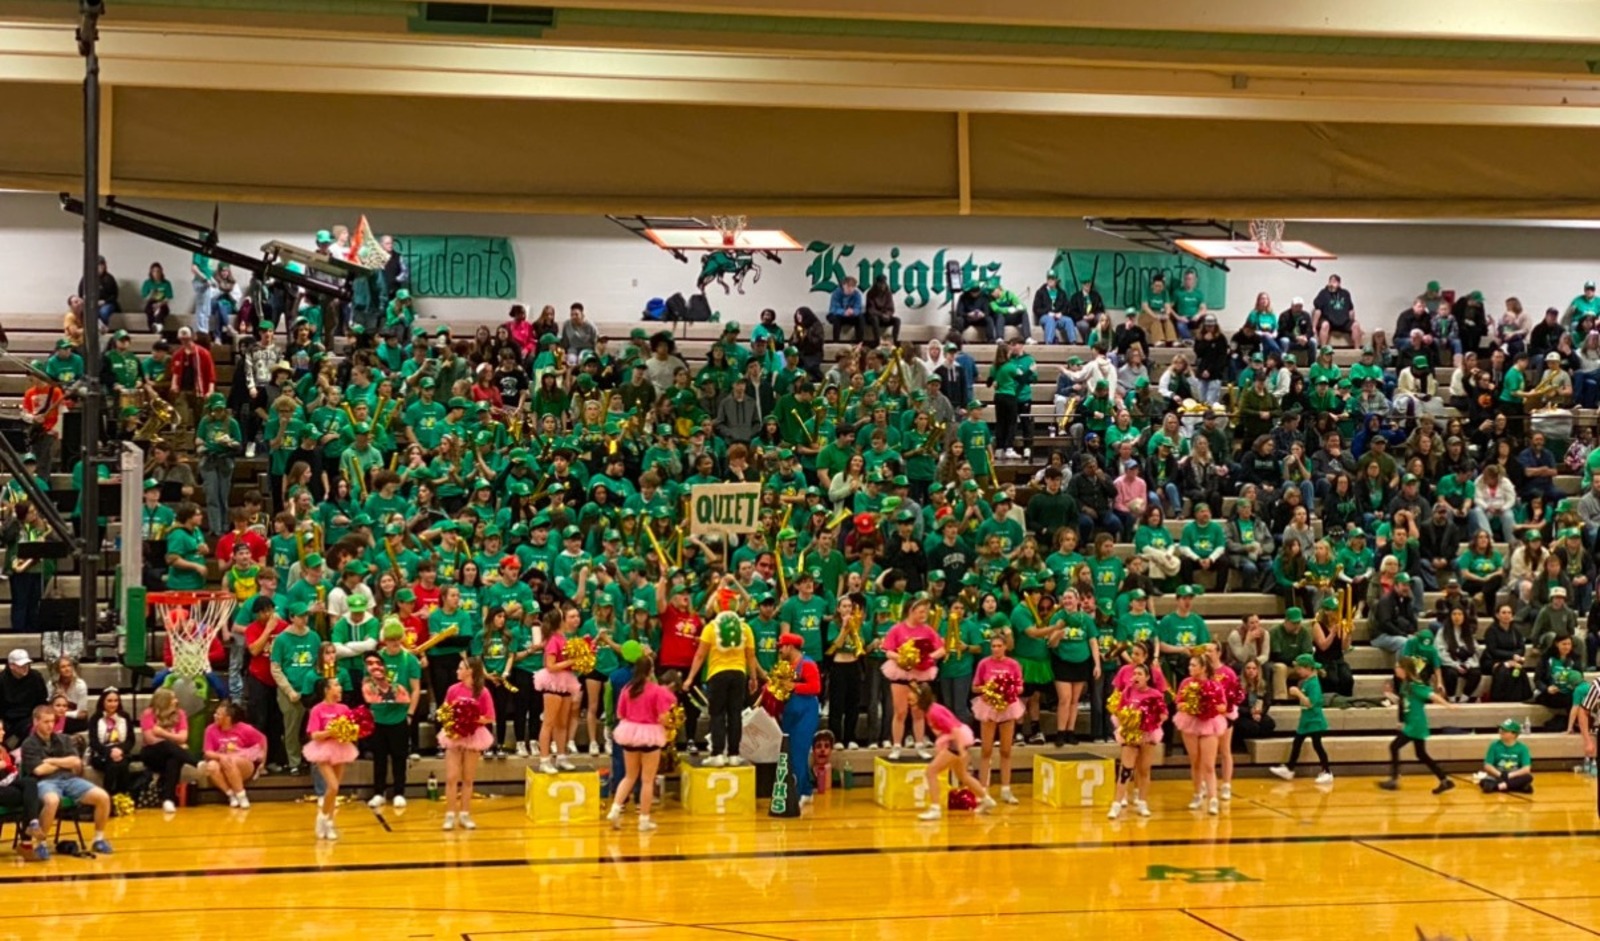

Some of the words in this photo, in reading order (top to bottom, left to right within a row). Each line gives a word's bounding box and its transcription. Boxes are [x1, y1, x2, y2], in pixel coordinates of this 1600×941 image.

[393, 237, 512, 298] tudents
[806, 240, 1001, 309] Knights
[696, 492, 758, 527] QUIET
[771, 753, 788, 813] EVHS
